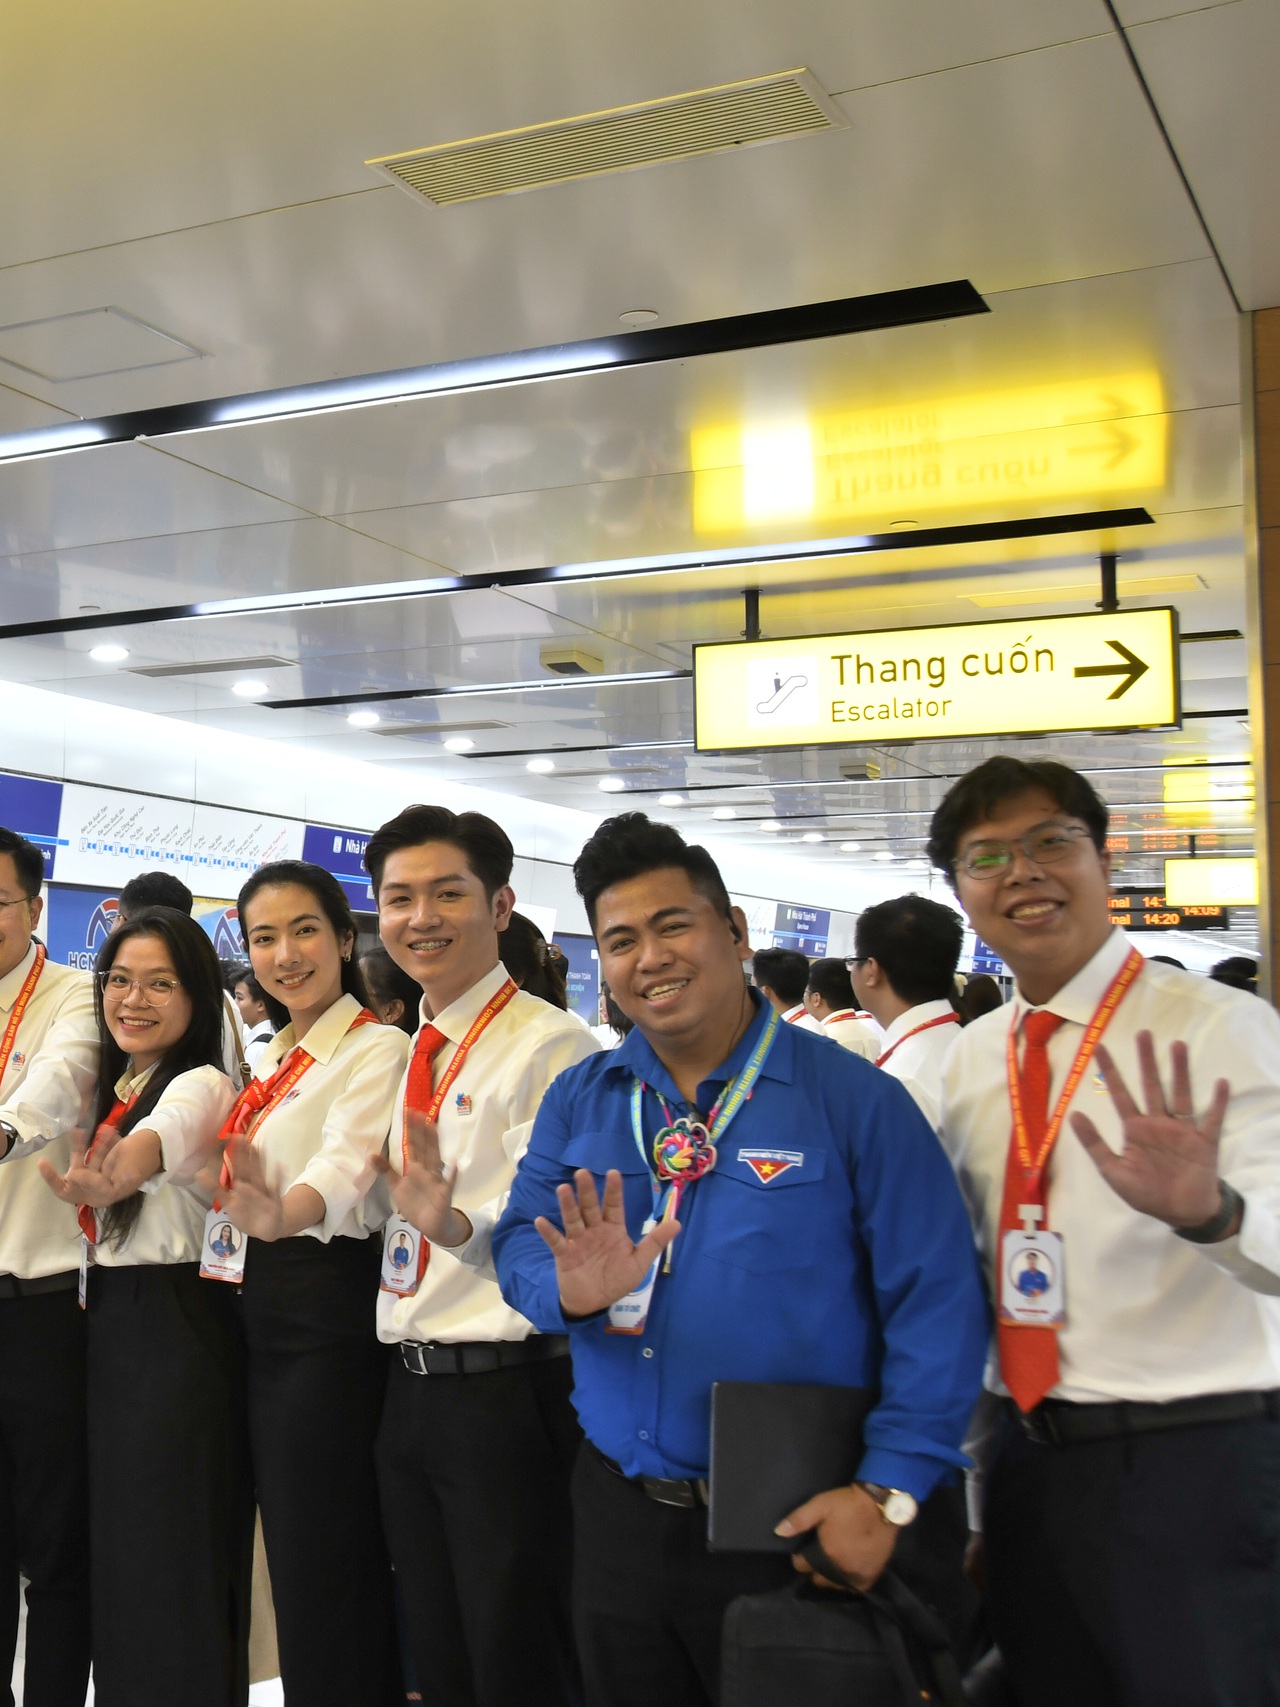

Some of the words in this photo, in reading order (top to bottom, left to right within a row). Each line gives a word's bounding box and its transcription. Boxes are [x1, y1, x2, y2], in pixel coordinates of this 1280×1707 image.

[831, 654, 945, 688] Thang
[962, 635, 1054, 677] cuốn
[832, 697, 952, 722] Escalator
[345, 838, 360, 854] Nhà
[1143, 913, 1180, 925] 14:20
[24, 974, 36, 991] THÀNH
[18, 991, 29, 1006] MINH
[490, 992, 507, 1010] MINH
[13, 1005, 22, 1016] CHÍ
[10, 1015, 18, 1024] HỒ
[461, 1007, 493, 1048] COMMUNIST
[6, 1024, 15, 1036] SẢN
[2, 1036, 12, 1053] CỘNG
[752, 1023, 776, 1065] COMMUNIST
[448, 1047, 465, 1071] YOUTH
[437, 1070, 453, 1095] UNION
[737, 1065, 757, 1091] YOUTH
[266, 1092, 281, 1111] CỘNG
[277, 1080, 290, 1095] SẢN
[286, 1072, 296, 1083] HỒ
[292, 1063, 304, 1076] CHÍ
[433, 1094, 442, 1105] OF
[723, 1090, 743, 1116] UNION
[427, 1104, 437, 1116] HO
[716, 1115, 727, 1127] OF
